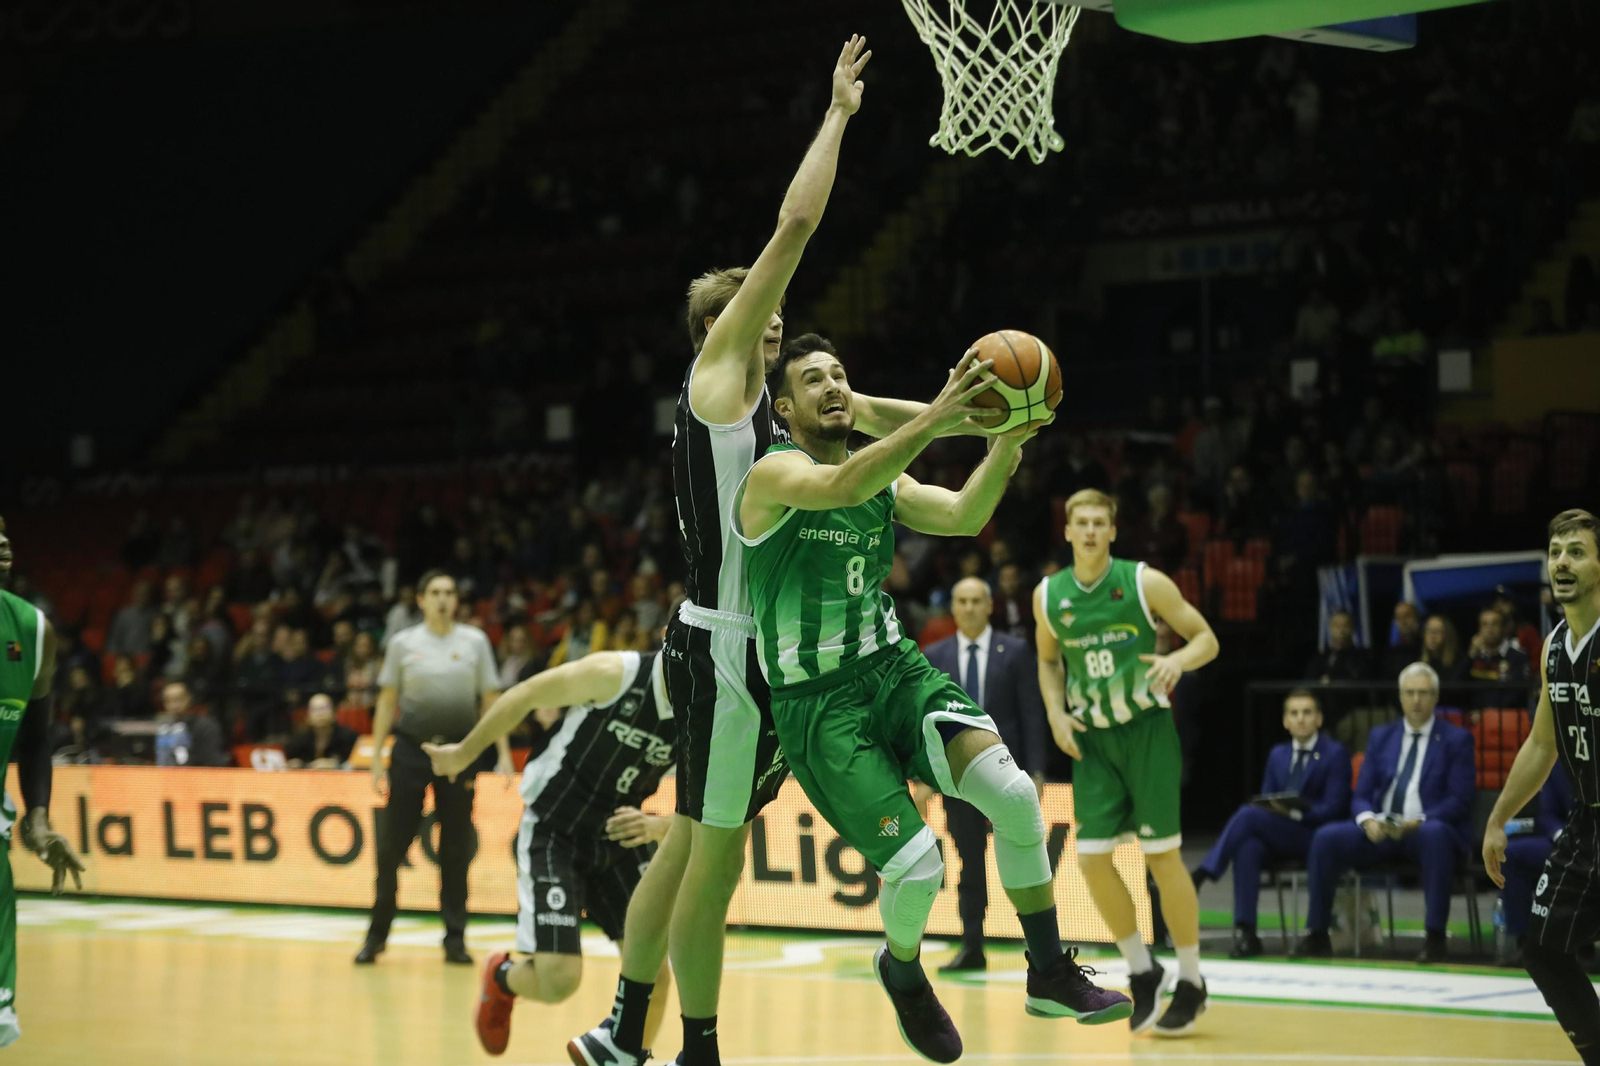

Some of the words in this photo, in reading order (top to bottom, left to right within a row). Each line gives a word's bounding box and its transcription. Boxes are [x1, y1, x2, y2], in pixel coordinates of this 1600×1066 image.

[799, 527, 860, 546] energía
[846, 555, 866, 596] 8
[1084, 648, 1116, 679] 88
[1547, 682, 1591, 705] RETA
[616, 765, 640, 794] 8
[78, 796, 134, 855] la
[163, 801, 279, 862] LEB
[752, 813, 944, 908] Lig
